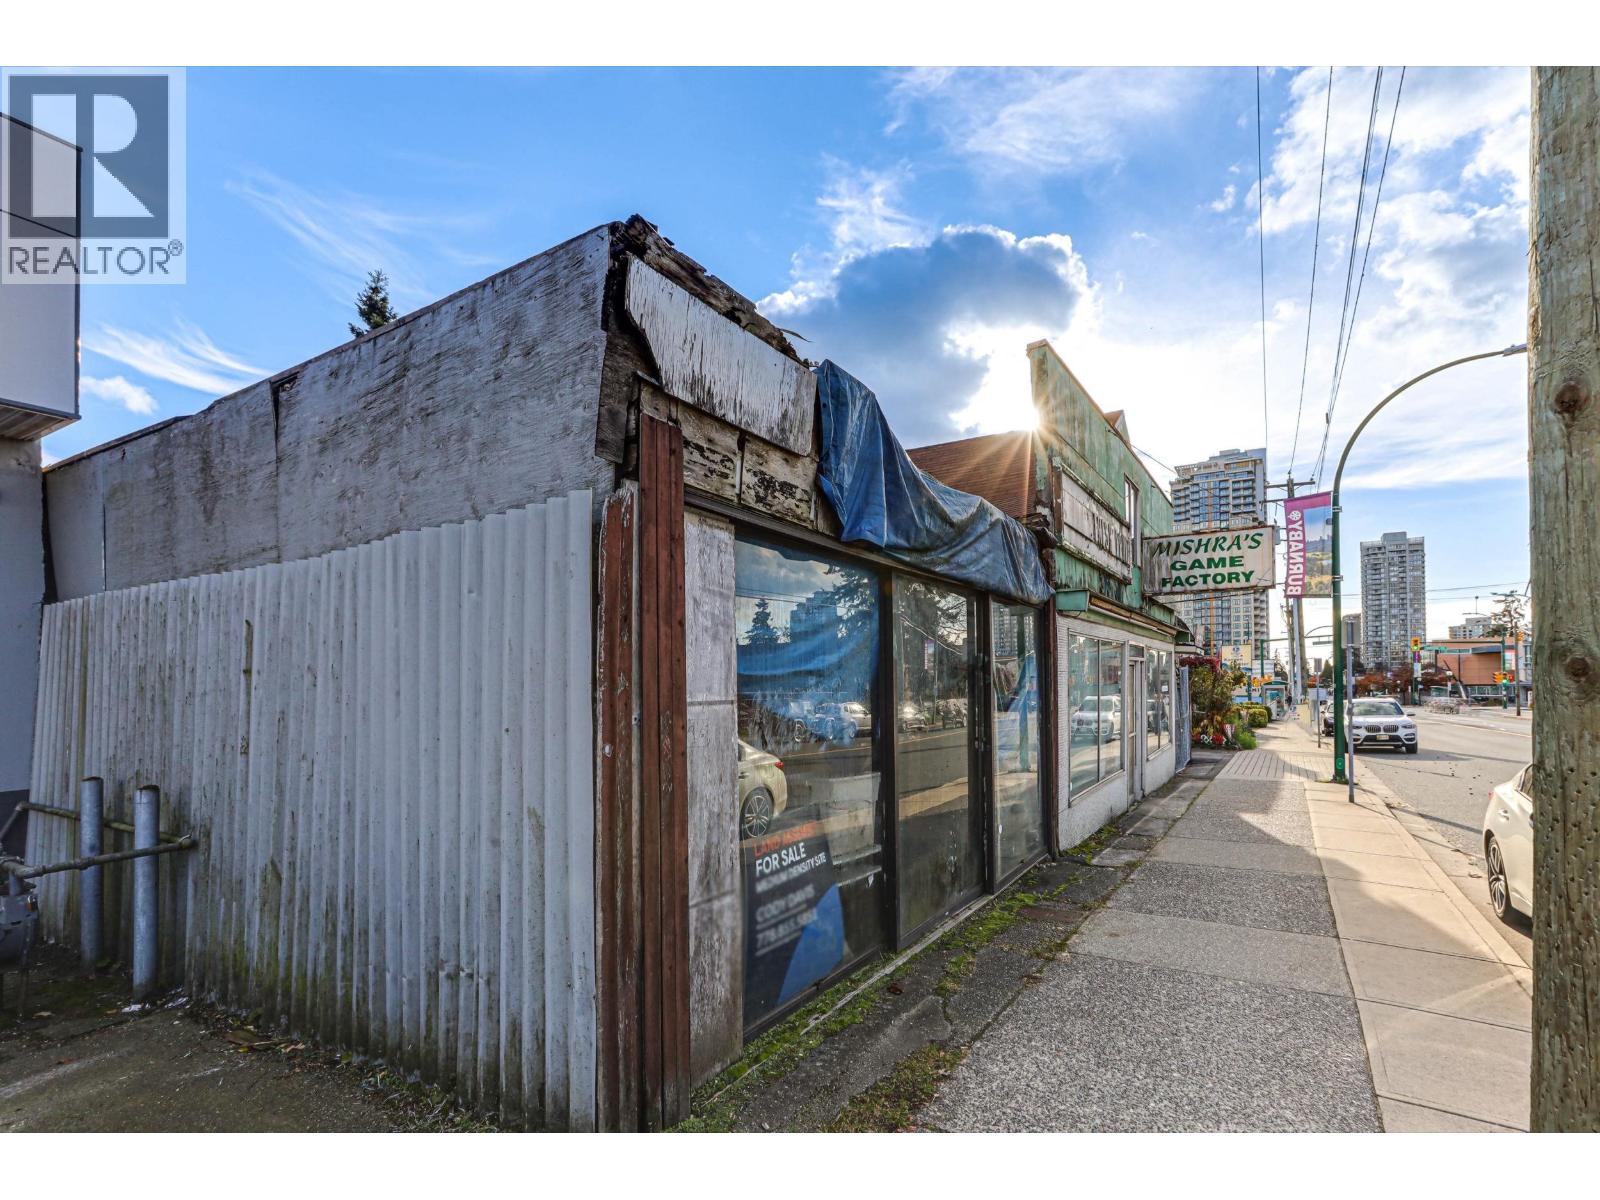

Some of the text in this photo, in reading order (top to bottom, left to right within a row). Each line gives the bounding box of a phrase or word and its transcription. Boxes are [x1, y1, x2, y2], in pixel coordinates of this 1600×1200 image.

[1152, 532, 1264, 557] MISHRA'S
[1170, 555, 1244, 571] GAME
[1161, 570, 1254, 587] FACTORY
[755, 842, 807, 877] FOR SALE
[815, 851, 827, 867] SITE
